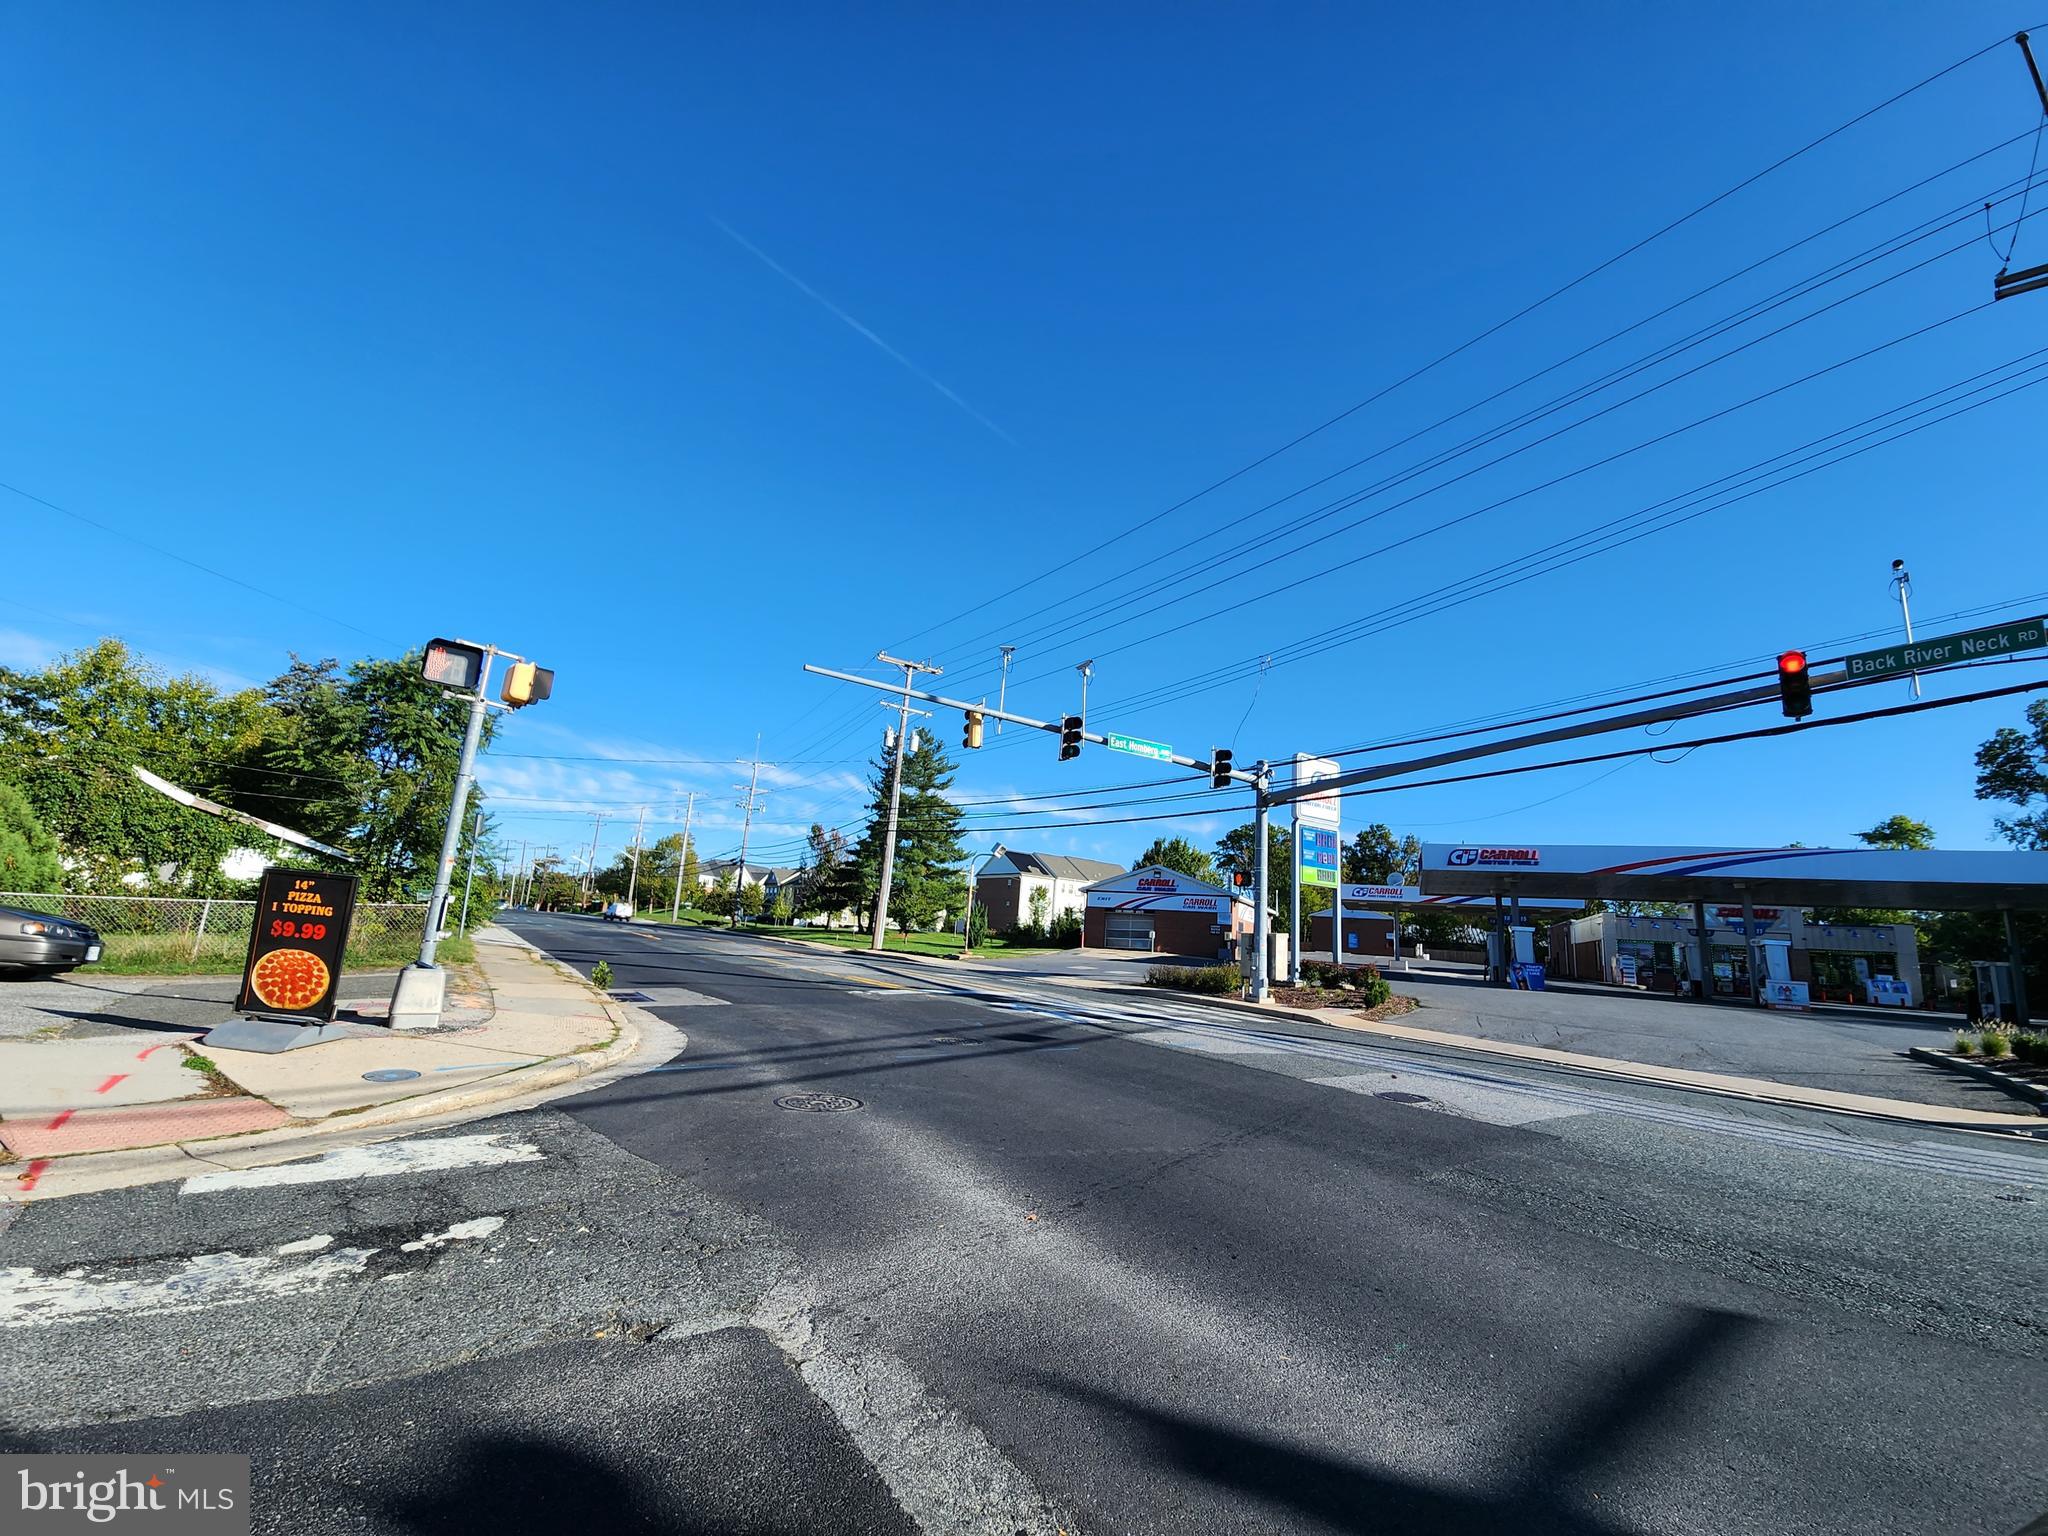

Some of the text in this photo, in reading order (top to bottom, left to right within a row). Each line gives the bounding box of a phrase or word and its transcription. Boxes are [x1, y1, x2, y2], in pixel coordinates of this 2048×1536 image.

[1852, 630, 2038, 674] Back River Neck RD
[1110, 736, 1127, 748] East
[1480, 849, 1539, 860] CARROLL
[1138, 878, 1176, 887] CARROLL
[287, 891, 321, 903] PIZZA
[1369, 887, 1403, 896] CARROLL
[1183, 898, 1217, 906] CARROLL
[282, 902, 333, 916] TOPPING
[271, 919, 326, 940] $9.99
